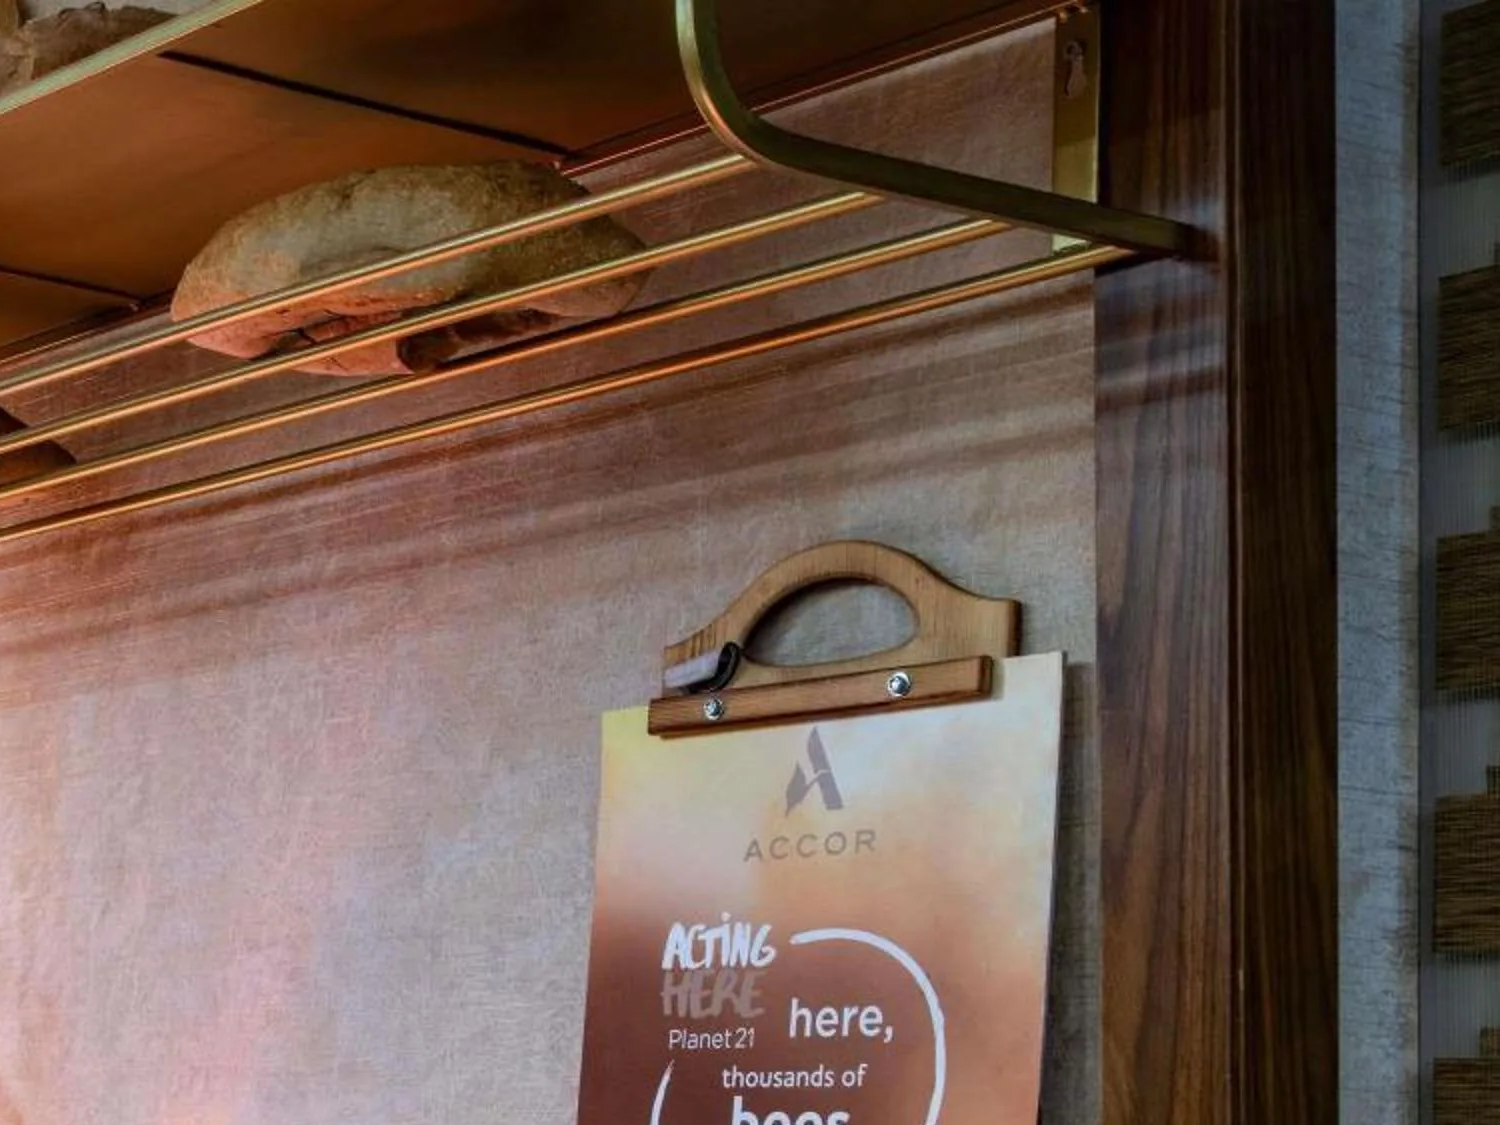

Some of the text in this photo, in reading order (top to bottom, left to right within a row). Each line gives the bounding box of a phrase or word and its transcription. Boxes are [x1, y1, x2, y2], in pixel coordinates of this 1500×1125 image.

[743, 829, 877, 862] ACCOR
[661, 969, 765, 1019] HERE
[788, 999, 894, 1042] here,
[669, 1027, 755, 1050] Planet 21
[722, 1064, 868, 1088] thousands of
